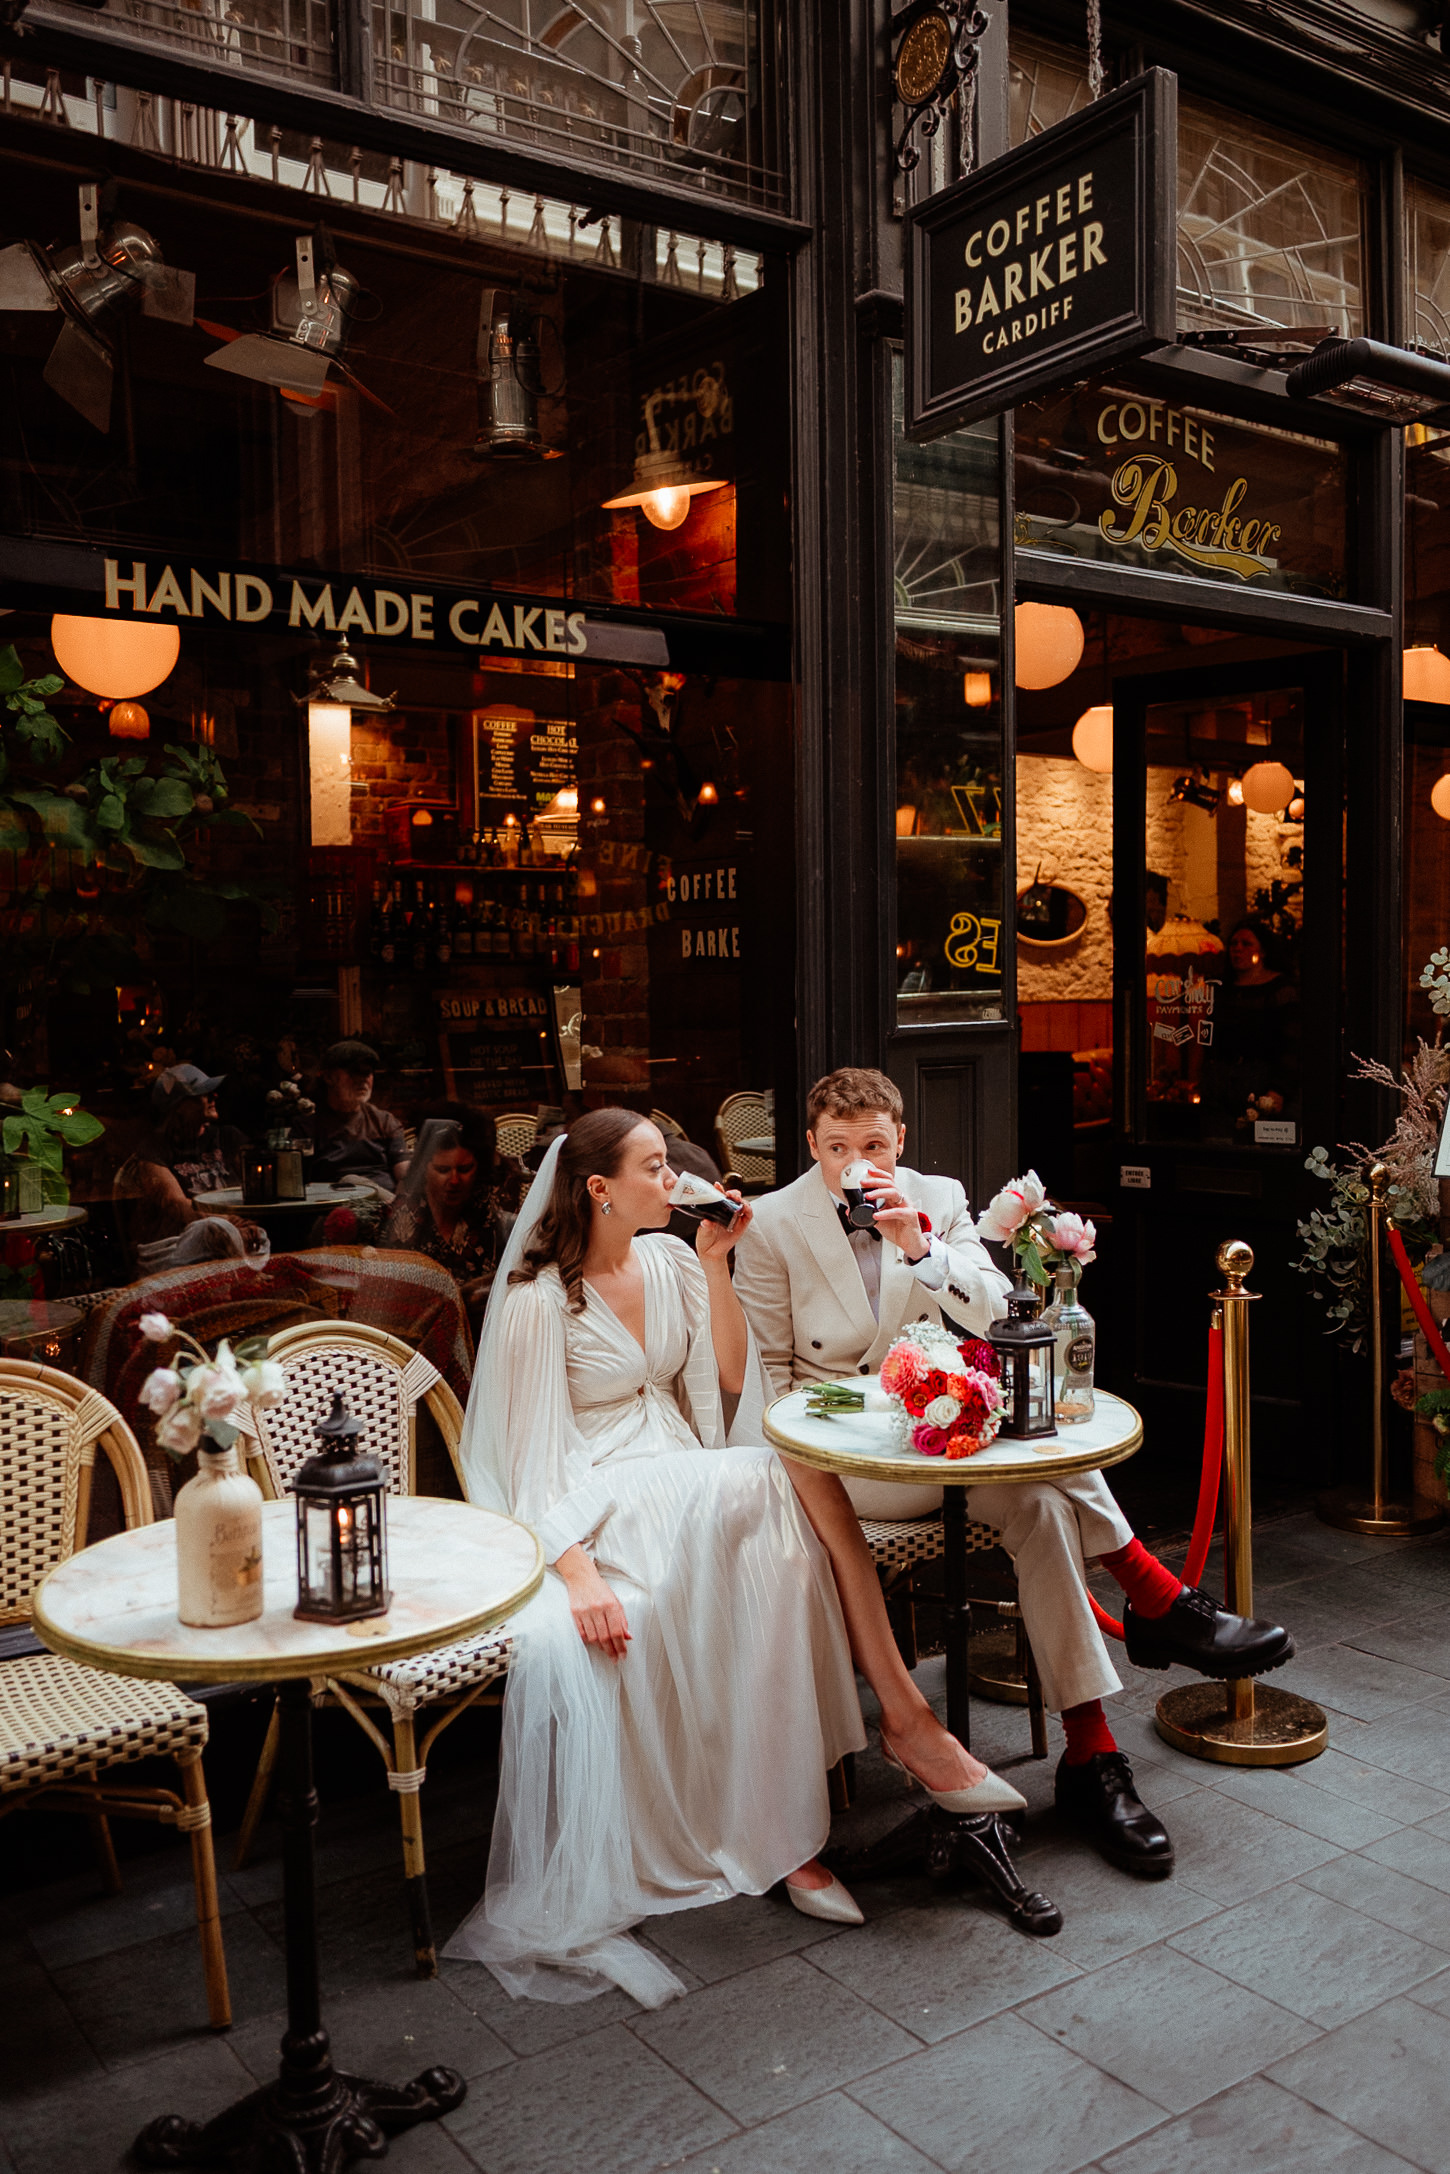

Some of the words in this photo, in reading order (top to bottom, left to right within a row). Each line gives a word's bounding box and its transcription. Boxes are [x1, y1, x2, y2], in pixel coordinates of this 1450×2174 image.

[965, 172, 1093, 268] COFFEE
[955, 221, 1108, 334] BARKER
[982, 296, 1073, 354] CARDIFF
[1097, 402, 1215, 473] COFFEE
[1099, 453, 1281, 580] Barker
[104, 558, 273, 622] HAND
[288, 579, 435, 641] MADE
[449, 601, 588, 655] CAKES
[483, 720, 517, 731] COFFEE
[547, 724, 566, 736] HOT
[667, 868, 737, 902] COFFEE
[682, 927, 741, 958] BARKE
[440, 999, 480, 1018] SOUP
[485, 999, 496, 1017] &
[498, 997, 549, 1017] BREAD
[1156, 1005, 1203, 1015] PAYMENTS
